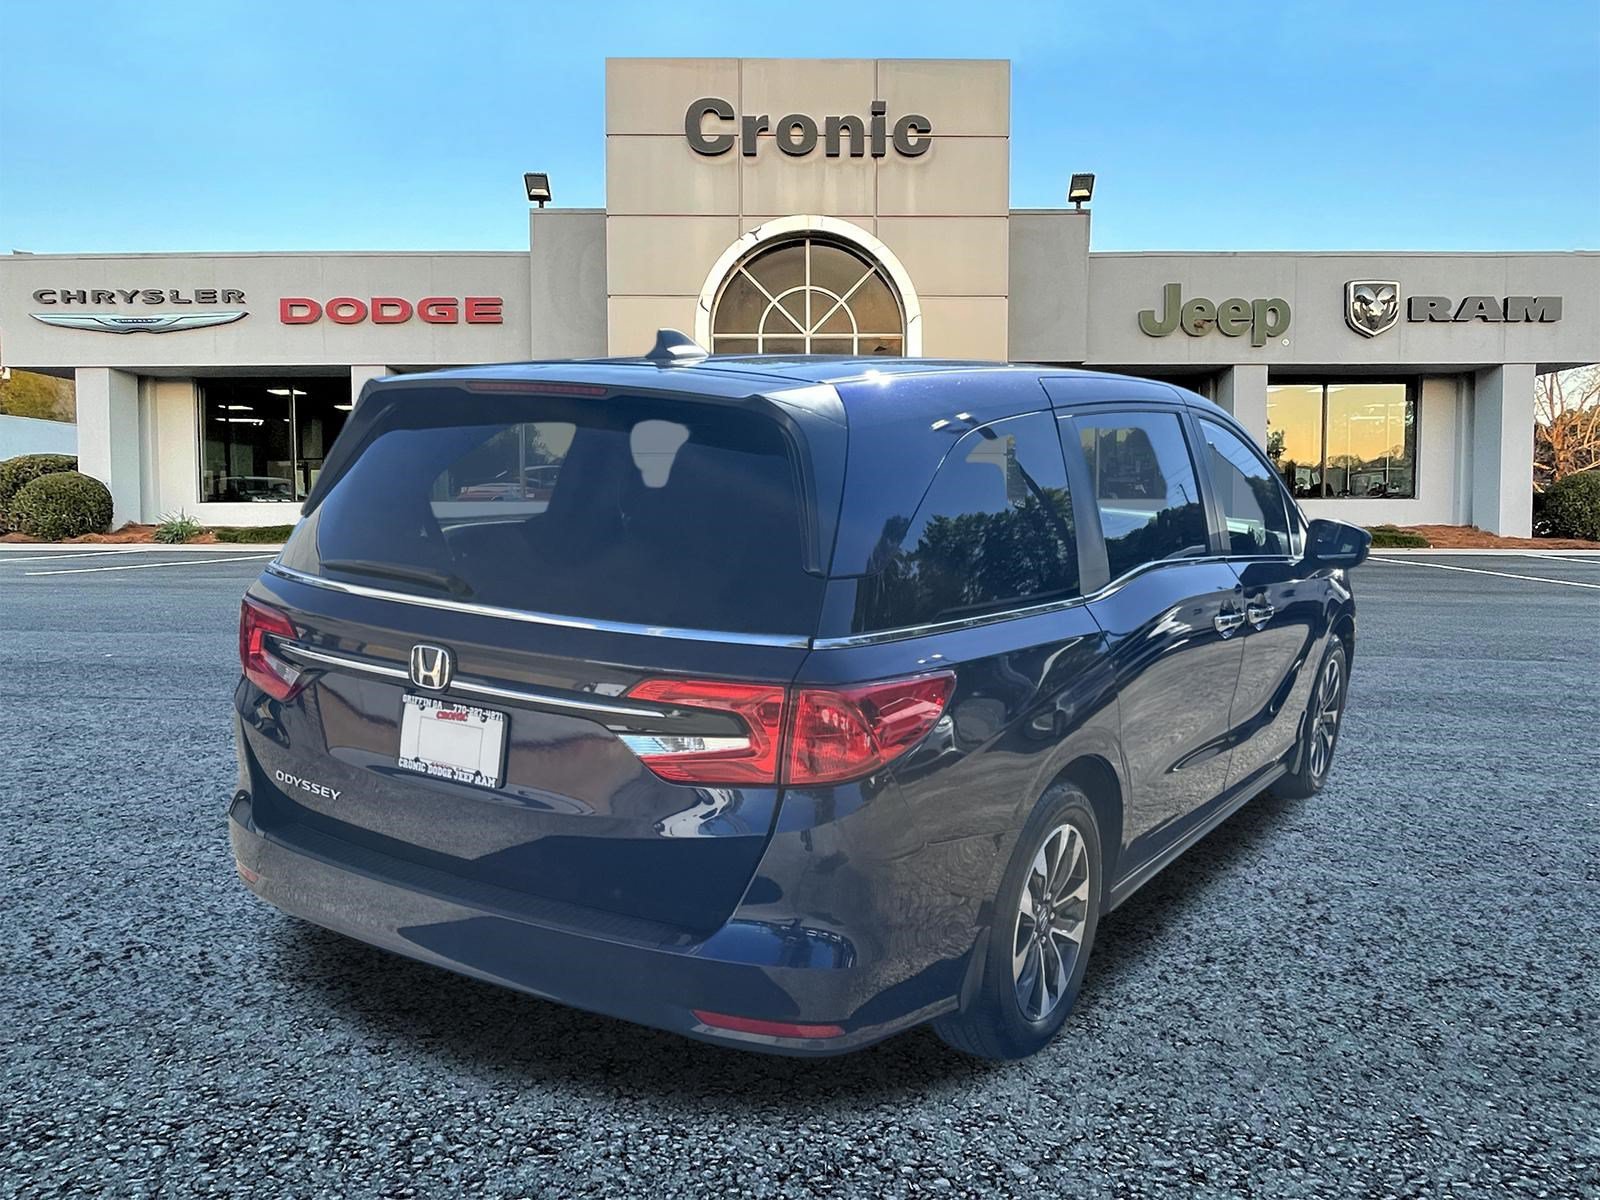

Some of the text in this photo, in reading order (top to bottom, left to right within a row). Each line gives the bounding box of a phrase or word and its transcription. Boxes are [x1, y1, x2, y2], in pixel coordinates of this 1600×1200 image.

[685, 97, 932, 157] Cronic
[32, 289, 246, 305] CHRYSLER
[280, 297, 504, 324] DODGE
[1407, 296, 1563, 323] RAM
[1138, 283, 1291, 347] Jeep
[275, 769, 342, 801] ODYSSEY
[398, 758, 426, 773] CRONIC
[427, 764, 453, 779] DODGE
[453, 770, 474, 784] JEEP
[474, 775, 497, 789] RAM
